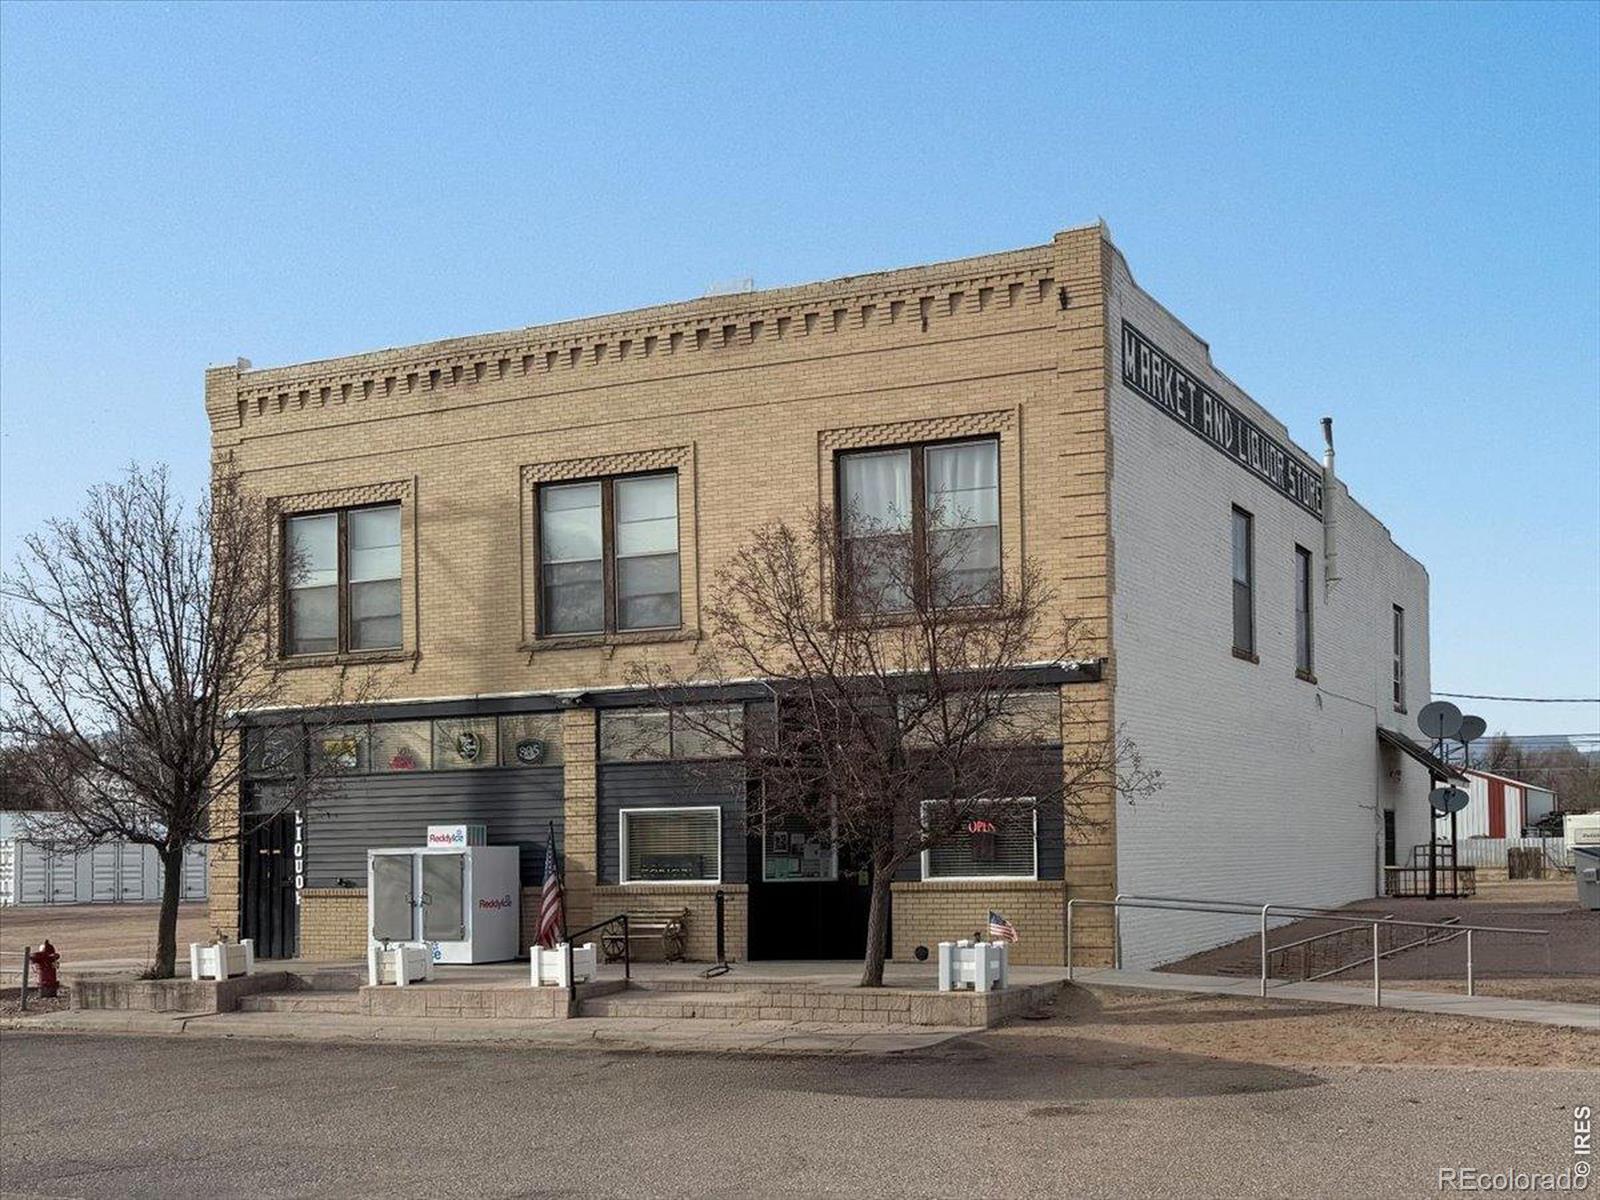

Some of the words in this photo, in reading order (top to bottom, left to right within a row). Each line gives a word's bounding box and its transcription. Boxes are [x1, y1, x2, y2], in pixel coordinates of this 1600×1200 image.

[1125, 334, 1196, 424] MARKET
[1203, 396, 1234, 449] AND
[1238, 420, 1285, 489] LIQUOR
